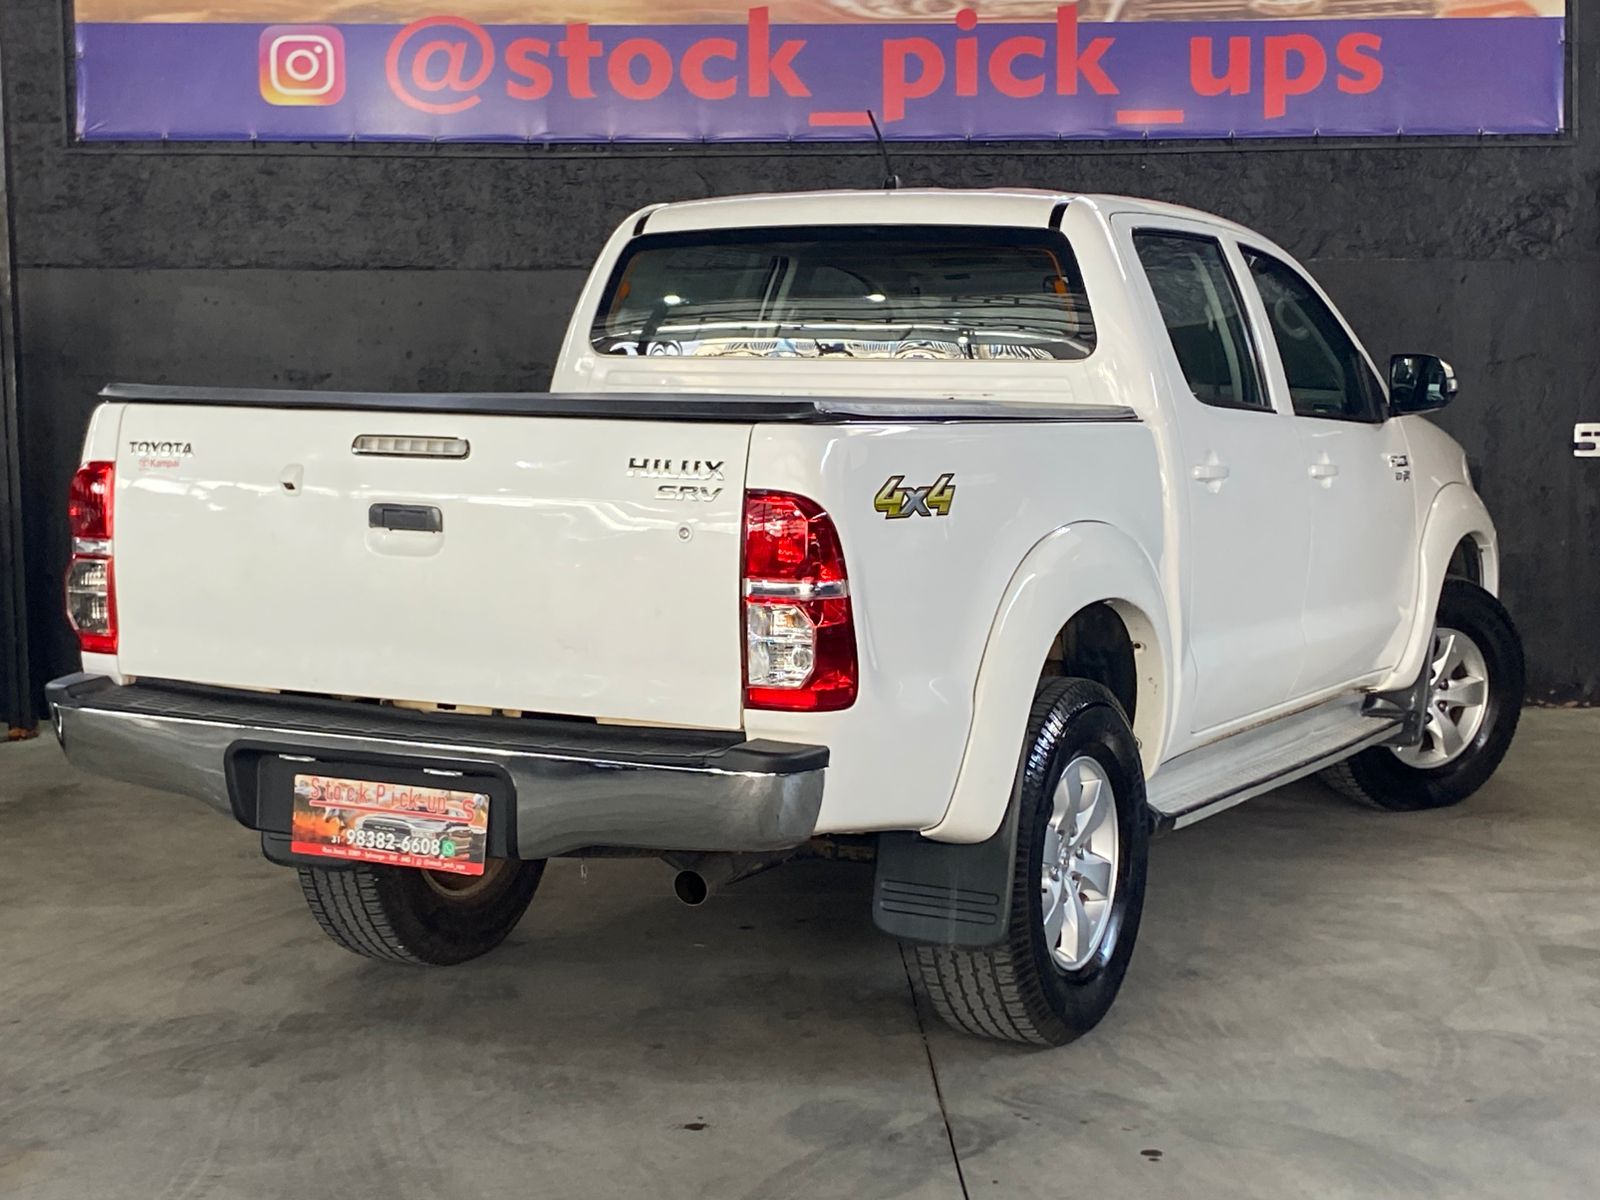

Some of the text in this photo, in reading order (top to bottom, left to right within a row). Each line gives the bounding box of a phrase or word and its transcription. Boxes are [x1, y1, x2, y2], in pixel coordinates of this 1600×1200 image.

[385, 4, 1384, 126] @stock_pick_ups
[129, 441, 194, 458] TOYOTA
[626, 457, 725, 481] HILUX
[655, 485, 723, 502] SRV
[874, 473, 956, 519] 4x4
[311, 777, 369, 803] Stock
[346, 829, 441, 856] 98382-6608
